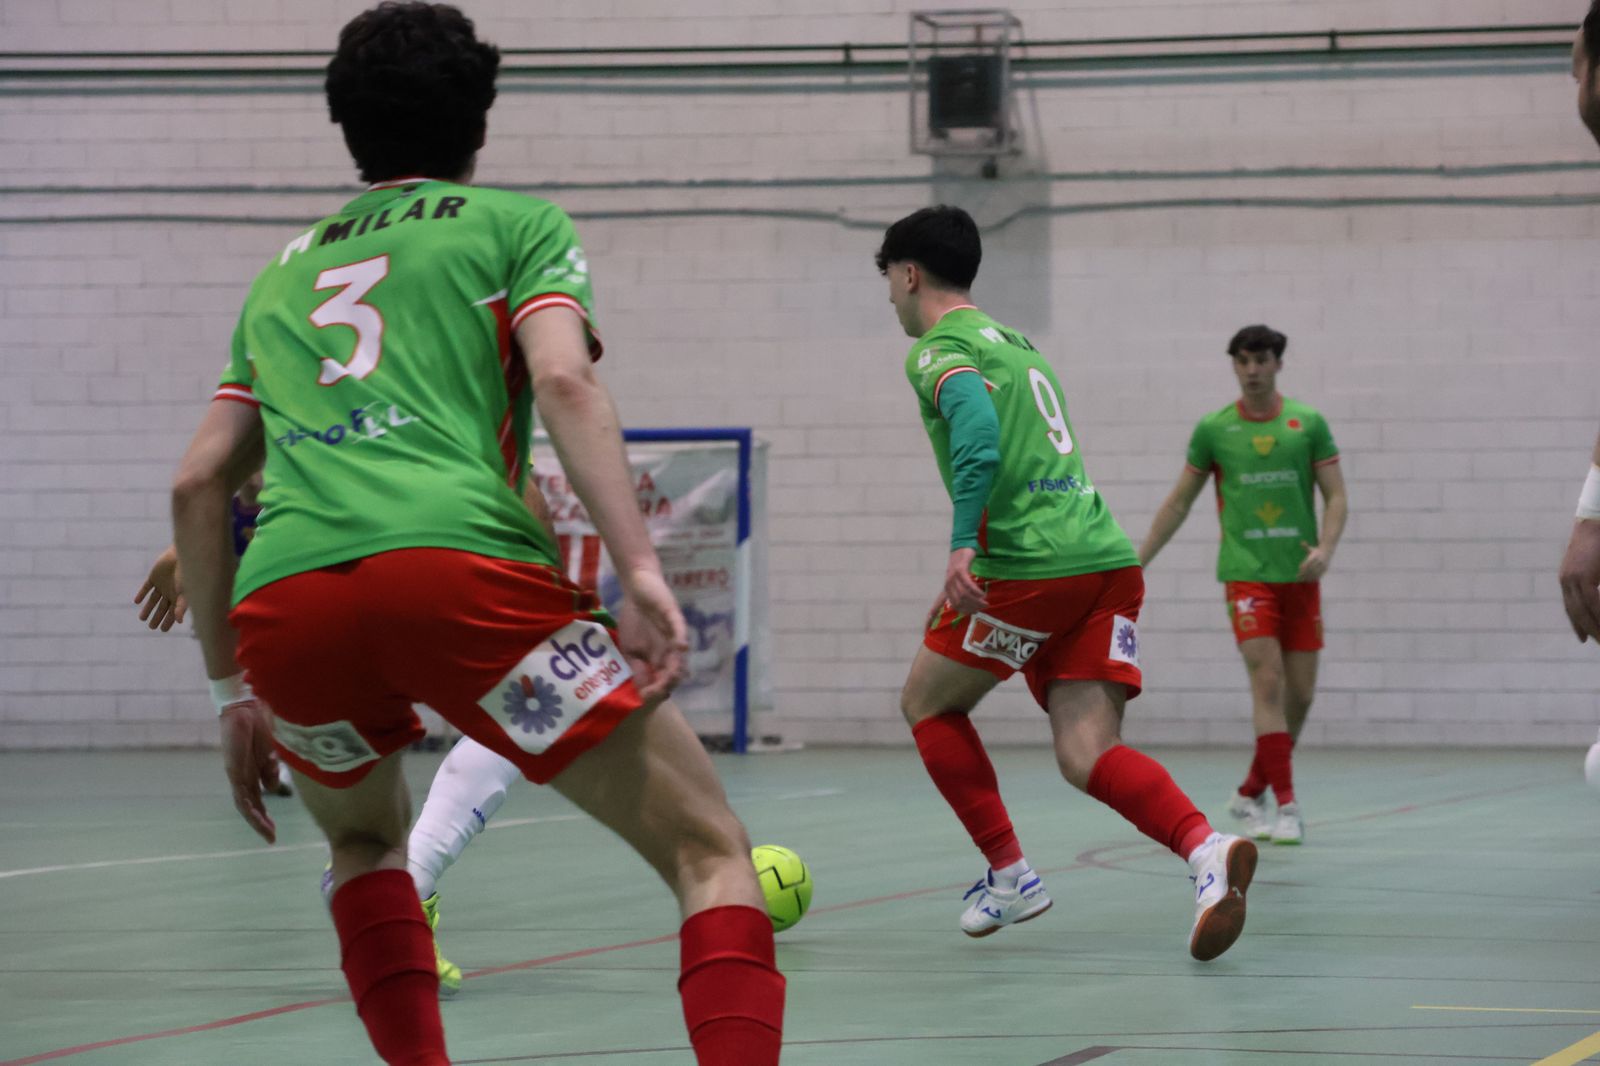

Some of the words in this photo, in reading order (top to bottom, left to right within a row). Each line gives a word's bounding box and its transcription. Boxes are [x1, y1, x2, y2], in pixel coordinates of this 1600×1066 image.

[320, 197, 466, 246] MILAR
[308, 254, 390, 386] 3
[1028, 367, 1074, 455] 9
[550, 626, 608, 680] chc
